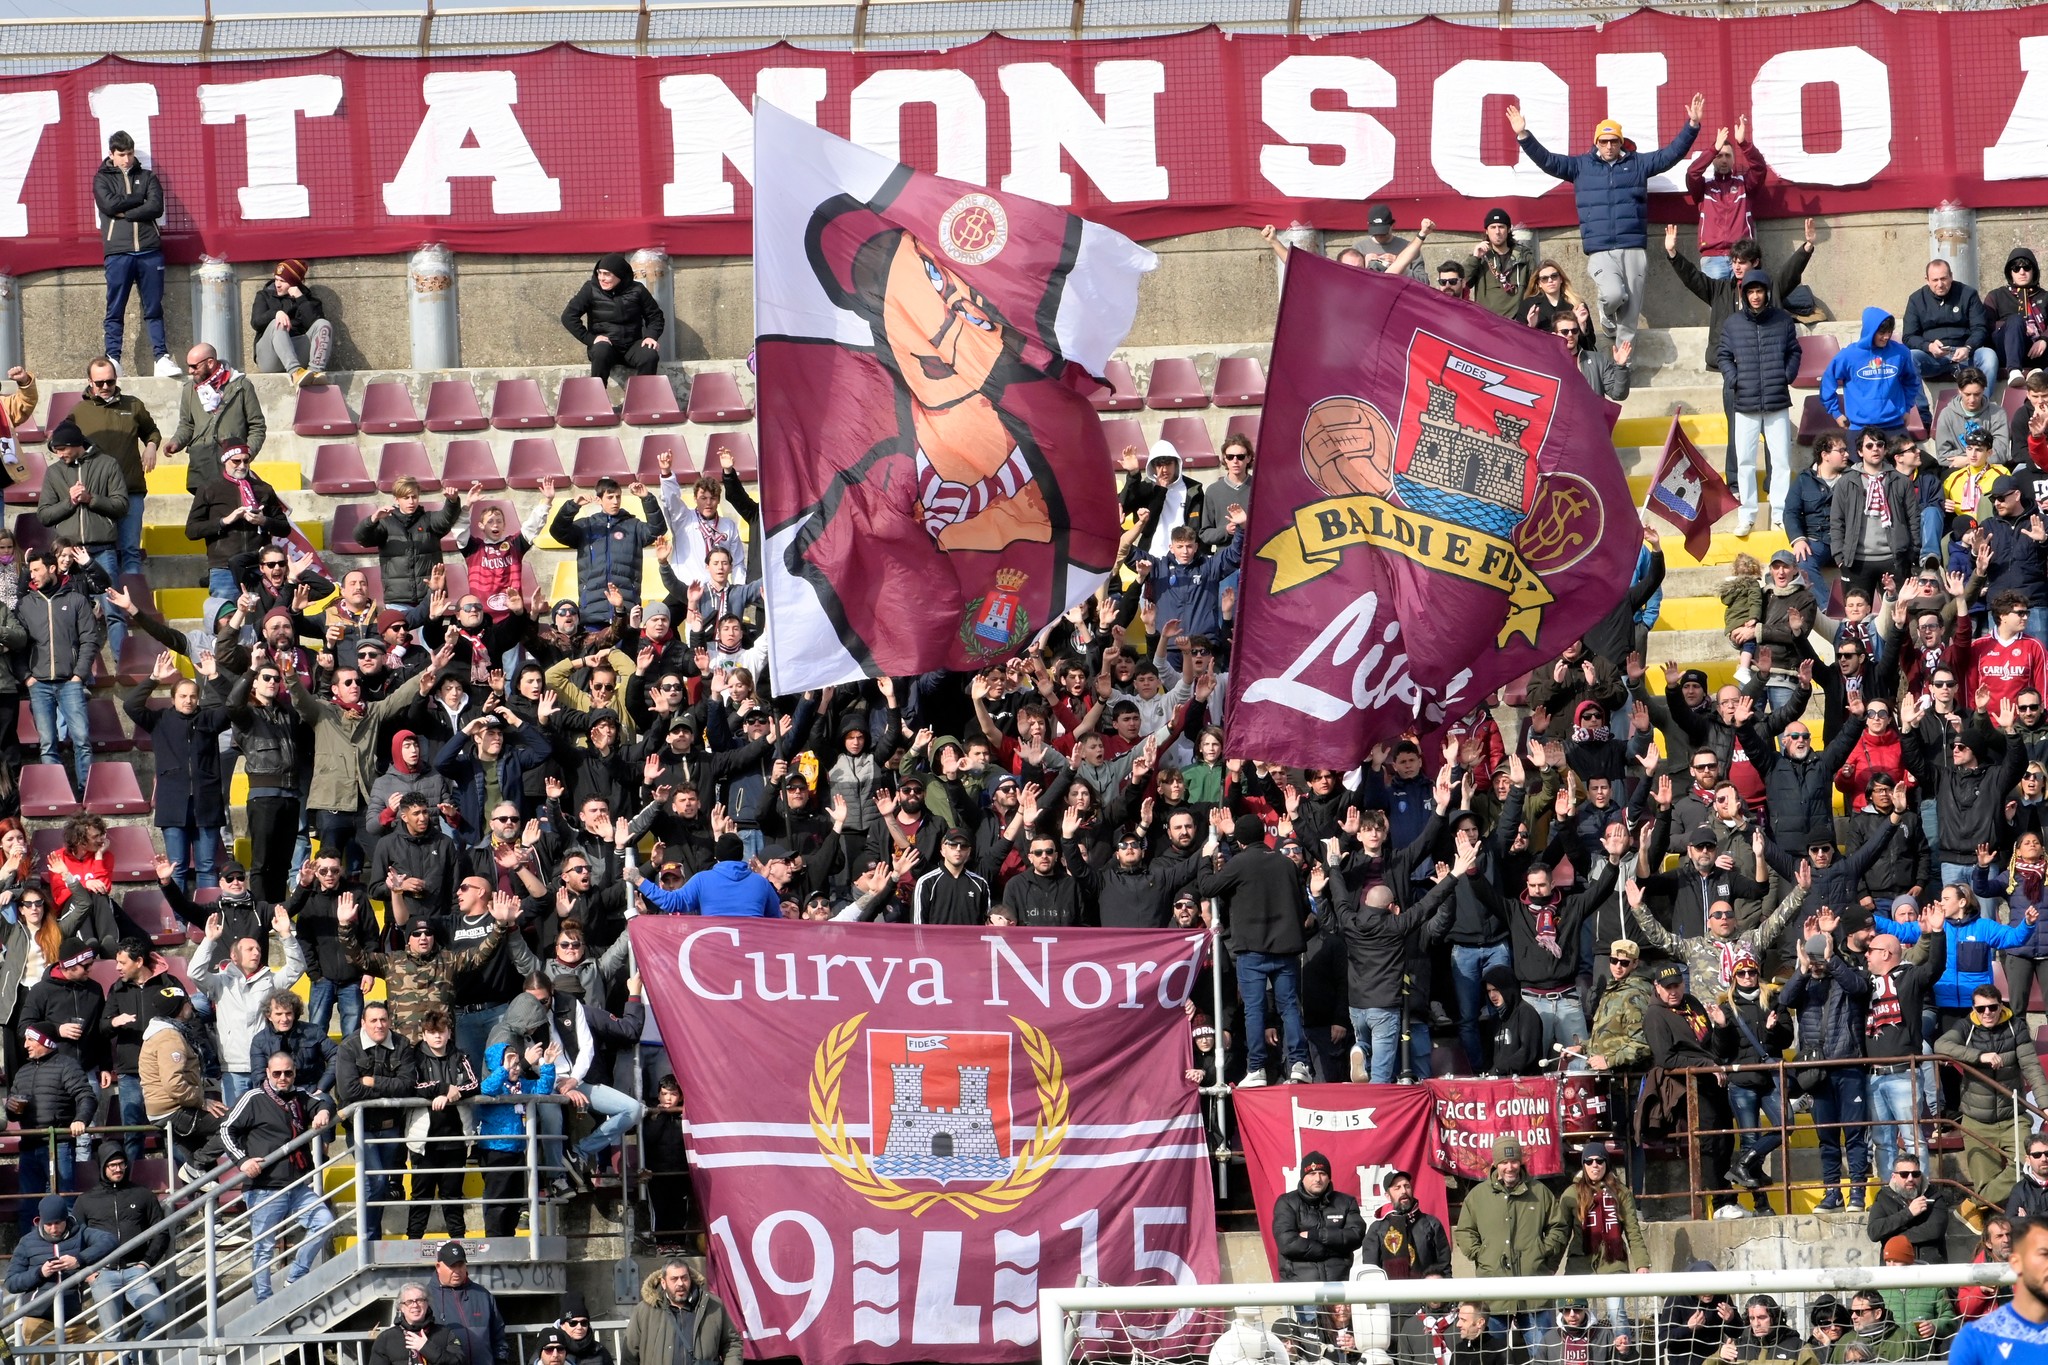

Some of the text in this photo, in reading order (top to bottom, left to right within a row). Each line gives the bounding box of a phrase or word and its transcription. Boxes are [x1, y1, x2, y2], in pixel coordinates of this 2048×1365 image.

[659, 60, 1169, 217] NON
[1260, 45, 1892, 200] SOLO
[1454, 361, 1487, 379] FIDES
[1315, 505, 1434, 557] BALDI
[1442, 532, 1471, 567] E
[1982, 666, 2025, 674] CARI LIV
[678, 926, 1207, 1009] Curva Nord
[909, 1039, 937, 1048] FIDES
[1307, 1111, 1360, 1127] 19 15
[1436, 1097, 1550, 1120] FACCE GIOVANI
[1440, 1127, 1494, 1148] VECCHI
[710, 1210, 835, 1341] 19
[1060, 1206, 1198, 1340] 15
[1566, 1350, 1587, 1360] 1915
